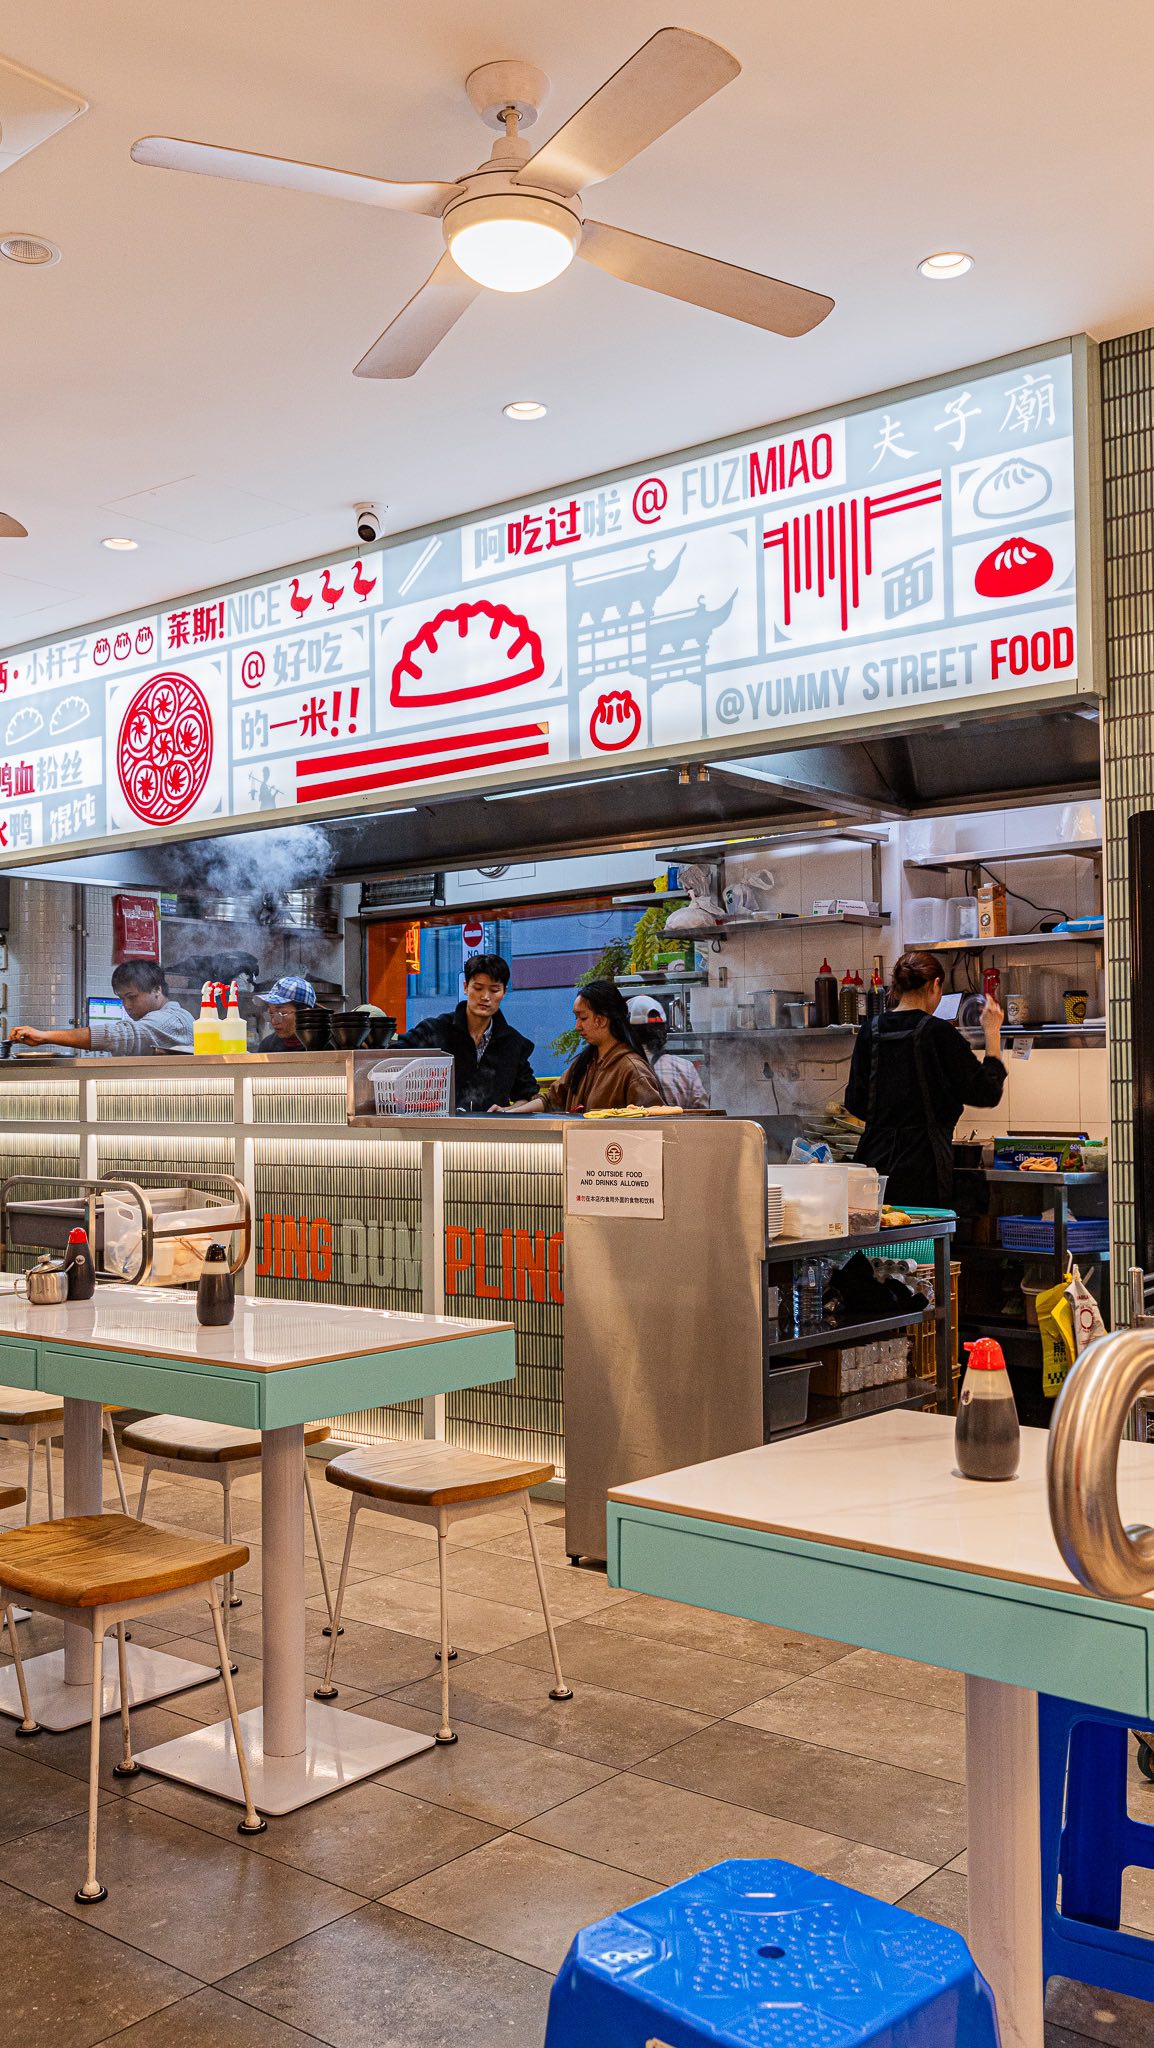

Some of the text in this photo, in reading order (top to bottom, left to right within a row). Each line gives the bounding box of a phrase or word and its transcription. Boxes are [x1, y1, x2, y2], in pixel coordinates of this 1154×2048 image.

[868, 374, 1056, 473] 夫子廟
[475, 433, 832, 568] 阿吃过啦 @ FUZIMIAO
[881, 547, 936, 620] 面
[241, 632, 343, 688] @ 好吃
[715, 627, 1074, 725] @YUMMY STREET FOOD
[597, 1170, 624, 1178] OUTSIDE
[256, 1213, 333, 1281] JING
